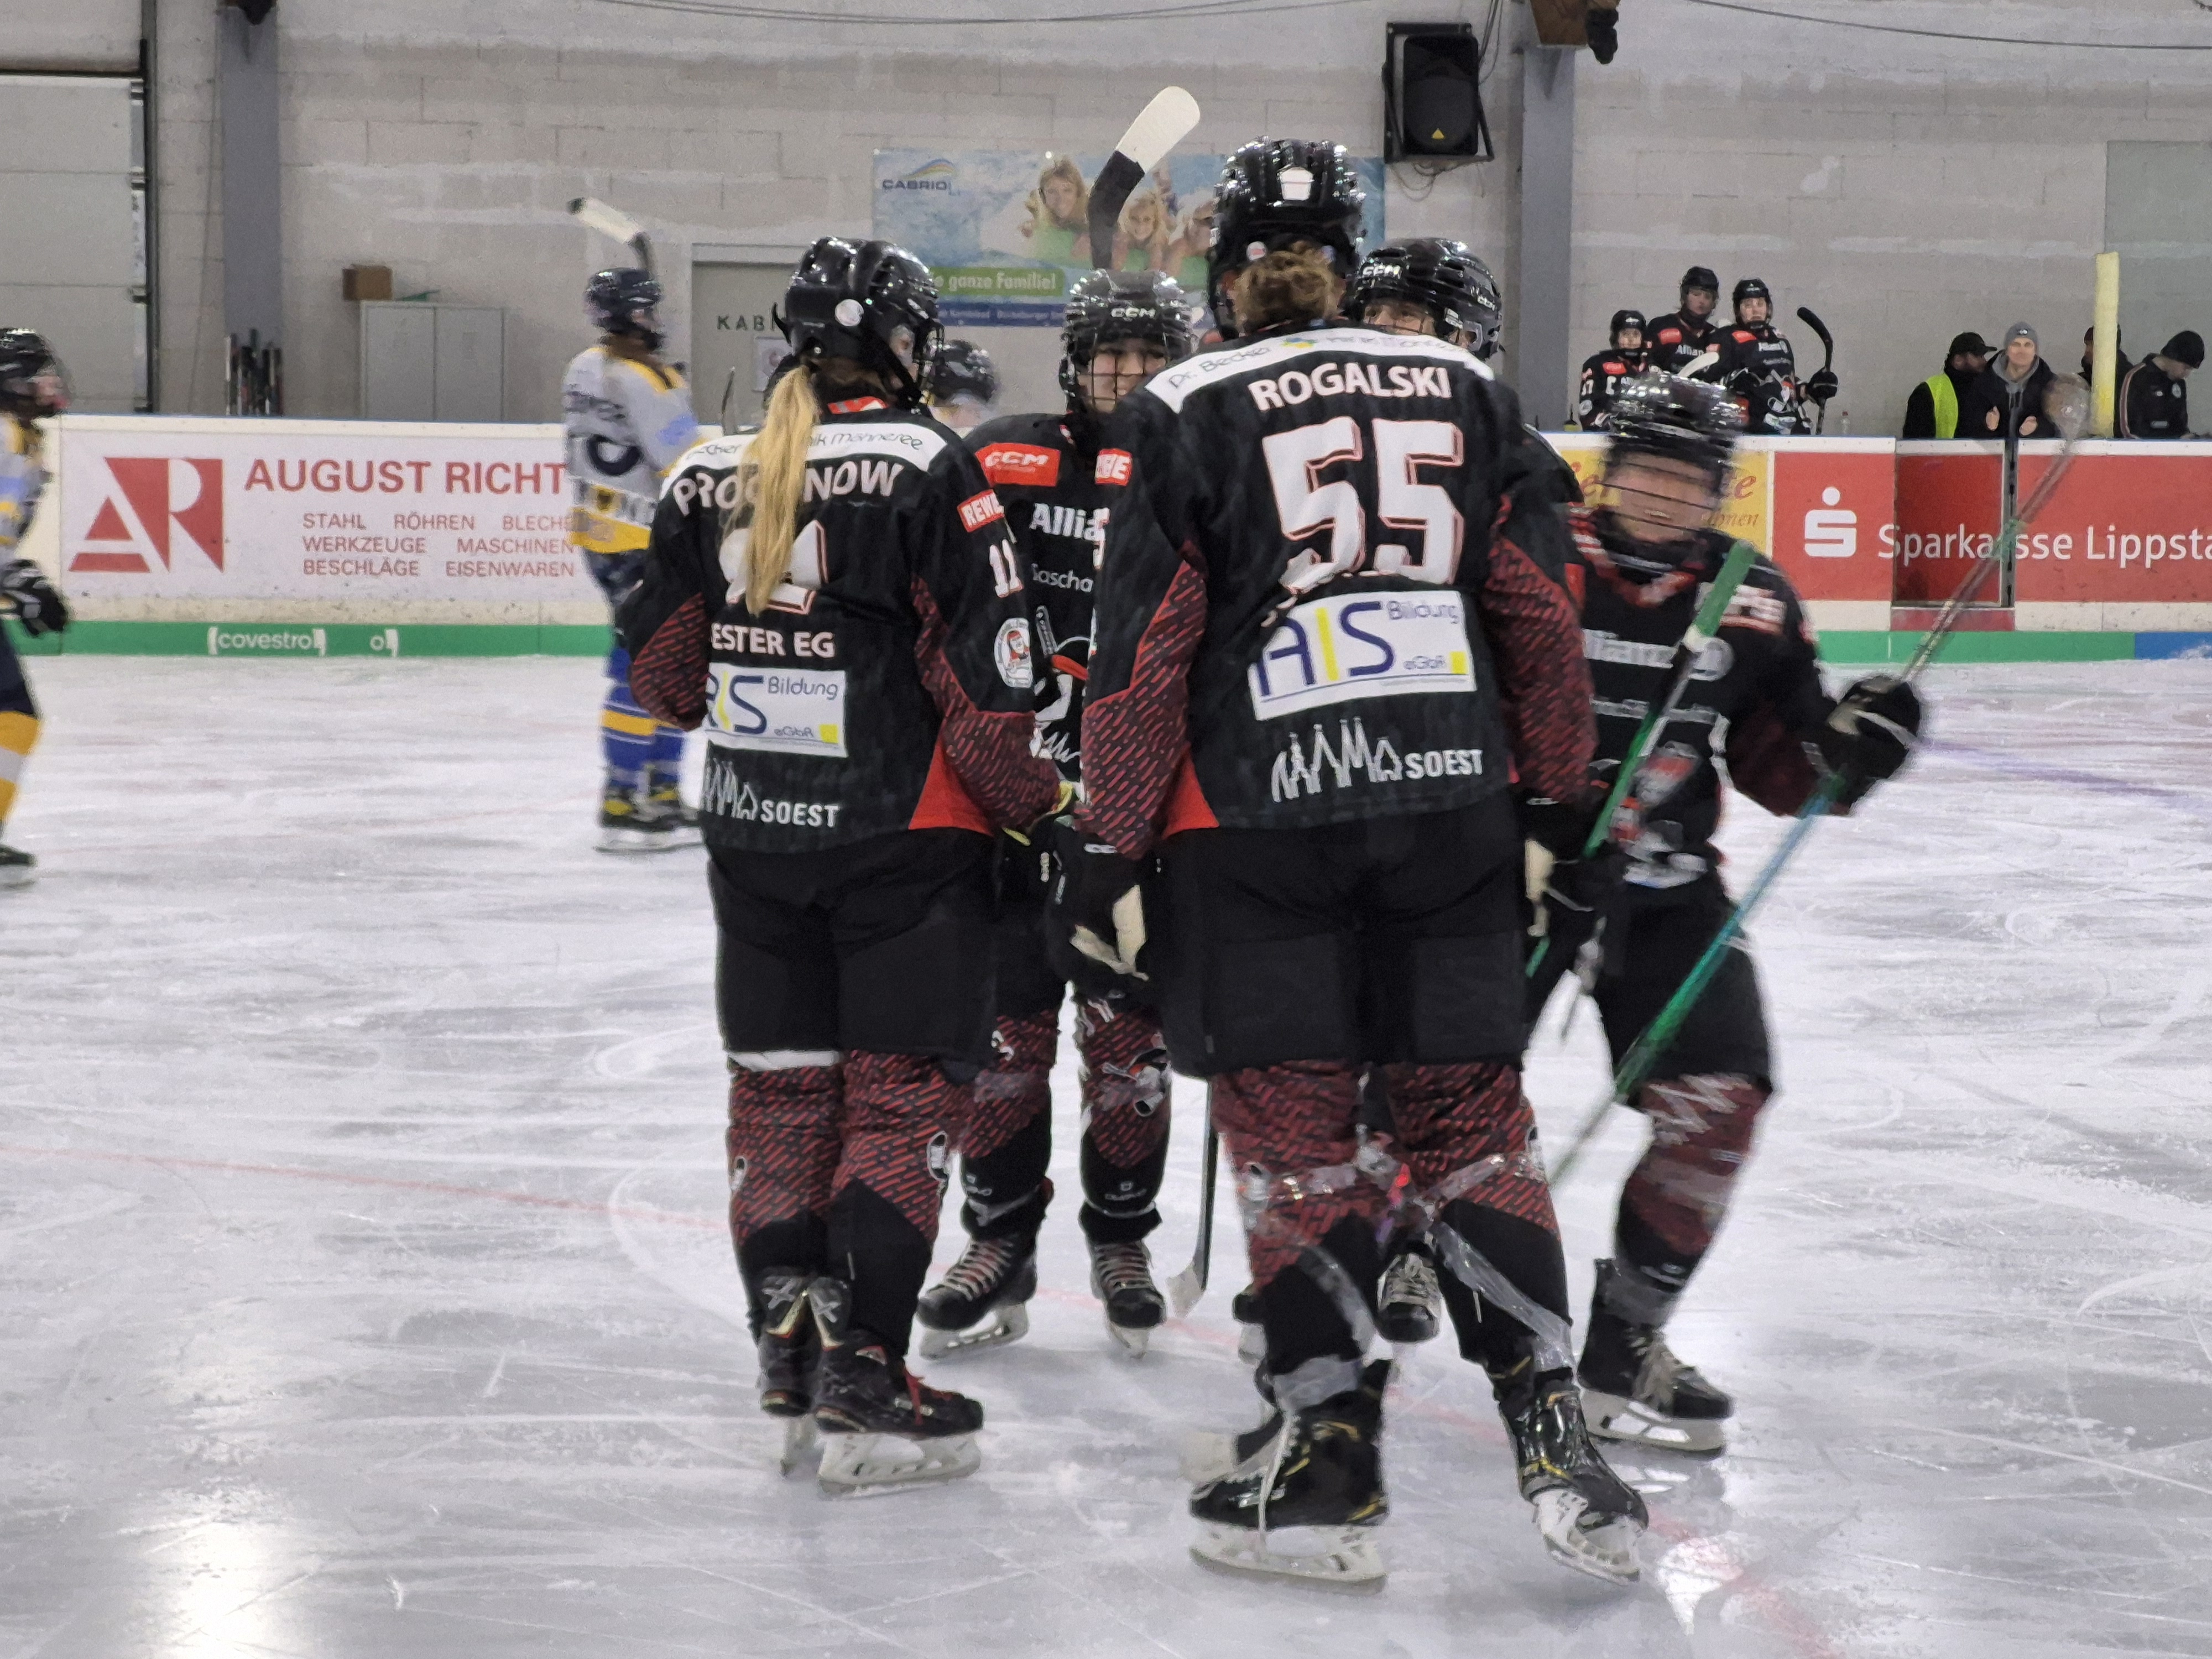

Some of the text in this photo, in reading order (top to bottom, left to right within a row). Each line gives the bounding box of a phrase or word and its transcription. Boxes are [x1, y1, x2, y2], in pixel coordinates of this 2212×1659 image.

[1110, 307, 1156, 318] CCM
[1248, 362, 1452, 412] ROGALSKI
[984, 451, 1049, 467] CCM
[244, 459, 568, 494] AUGUST RICHT
[1262, 415, 1465, 596] 55
[302, 512, 367, 530] STAHL
[394, 510, 475, 531] RÖHREN
[302, 535, 575, 554] WERKZEUGE MASCHINEN
[1878, 523, 2073, 567] Sparkasse
[302, 557, 575, 577] BESCHLÄGE EISENWAREN
[218, 631, 313, 650] covestro
[793, 631, 836, 658] EG
[768, 676, 839, 701] Bildung
[1404, 749, 1483, 780] SOEST
[760, 799, 841, 828] SOEST
